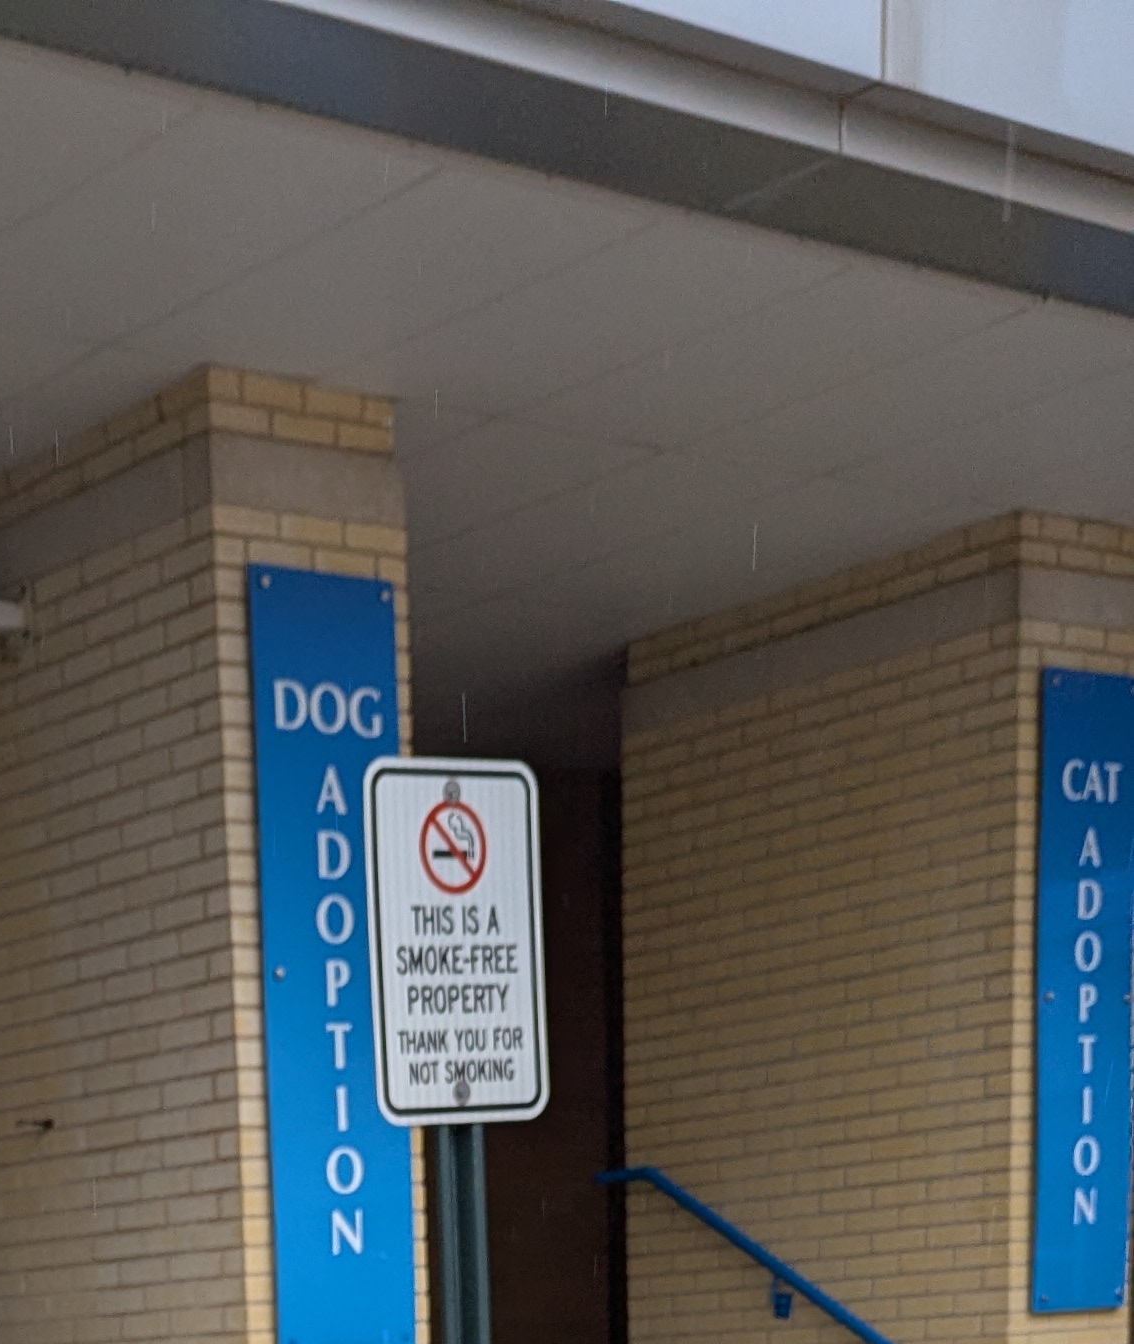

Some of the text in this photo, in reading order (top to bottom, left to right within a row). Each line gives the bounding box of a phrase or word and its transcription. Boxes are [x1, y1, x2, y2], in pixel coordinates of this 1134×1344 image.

[273, 677, 384, 739] DOG
[1062, 758, 1124, 805] CAT
[410, 904, 500, 936] THIS IS A
[396, 944, 518, 976] SMOKE-FREE
[315, 763, 364, 1256] ADOPTION
[407, 983, 509, 1015] PROPERTY
[397, 1026, 523, 1054] THANK YOU FOR
[1072, 826, 1103, 1225] ADOPTION
[409, 1058, 515, 1086] NOT SMOKING
